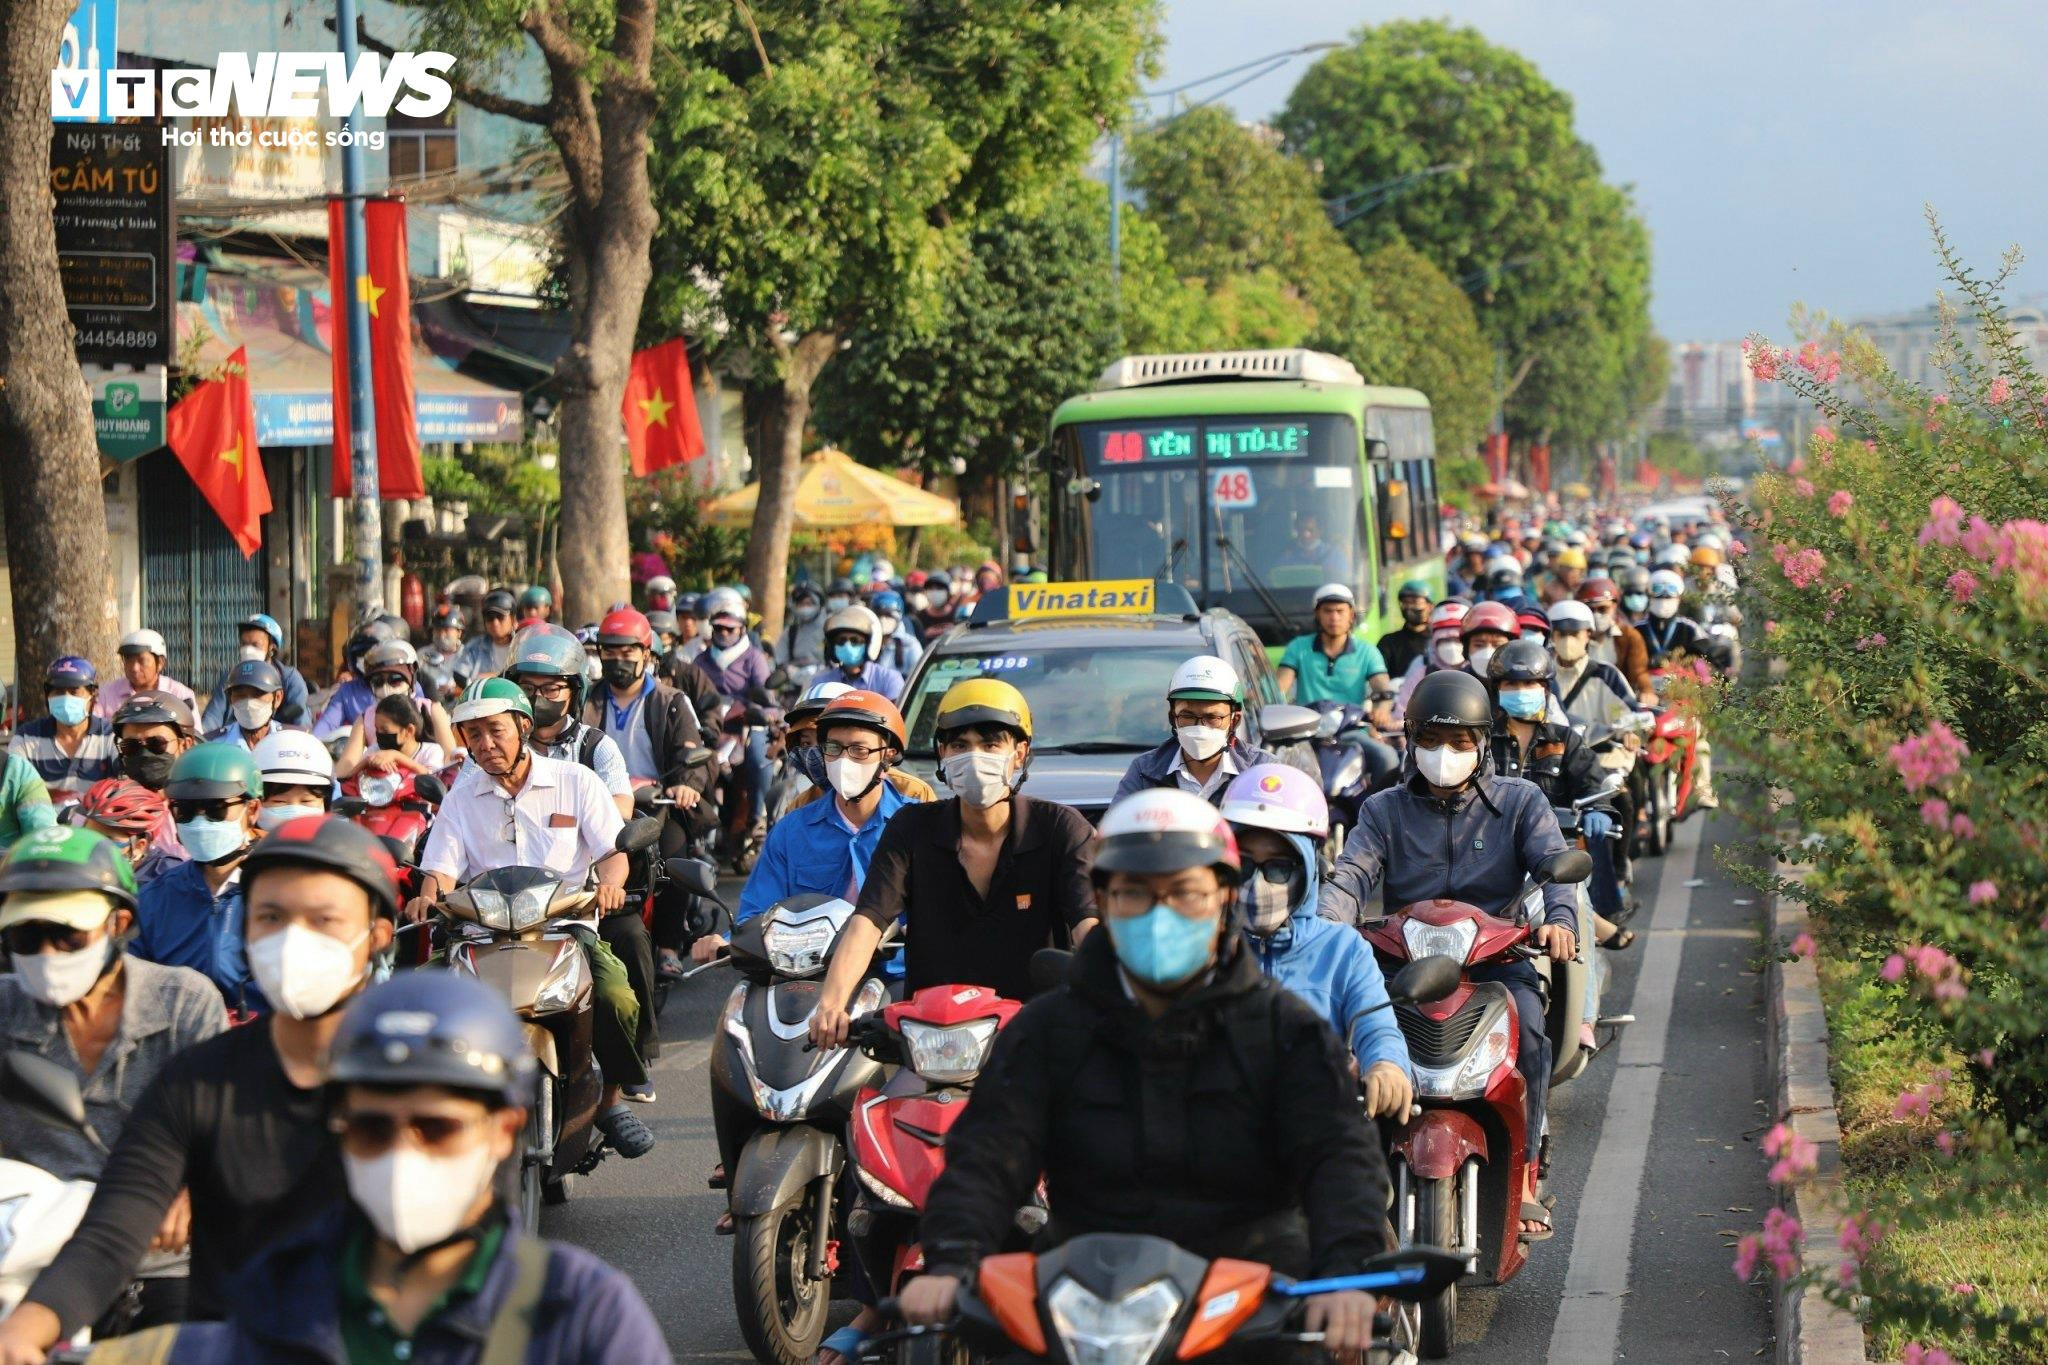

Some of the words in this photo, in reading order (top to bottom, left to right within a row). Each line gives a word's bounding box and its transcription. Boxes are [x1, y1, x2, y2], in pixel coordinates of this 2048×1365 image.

[67, 133, 96, 153] Nội
[122, 161, 158, 195] TÚ
[1216, 474, 1249, 501] 48
[1016, 586, 1149, 612] Vinataxi
[983, 657, 1028, 670] 1998
[1427, 714, 1460, 725] Andes
